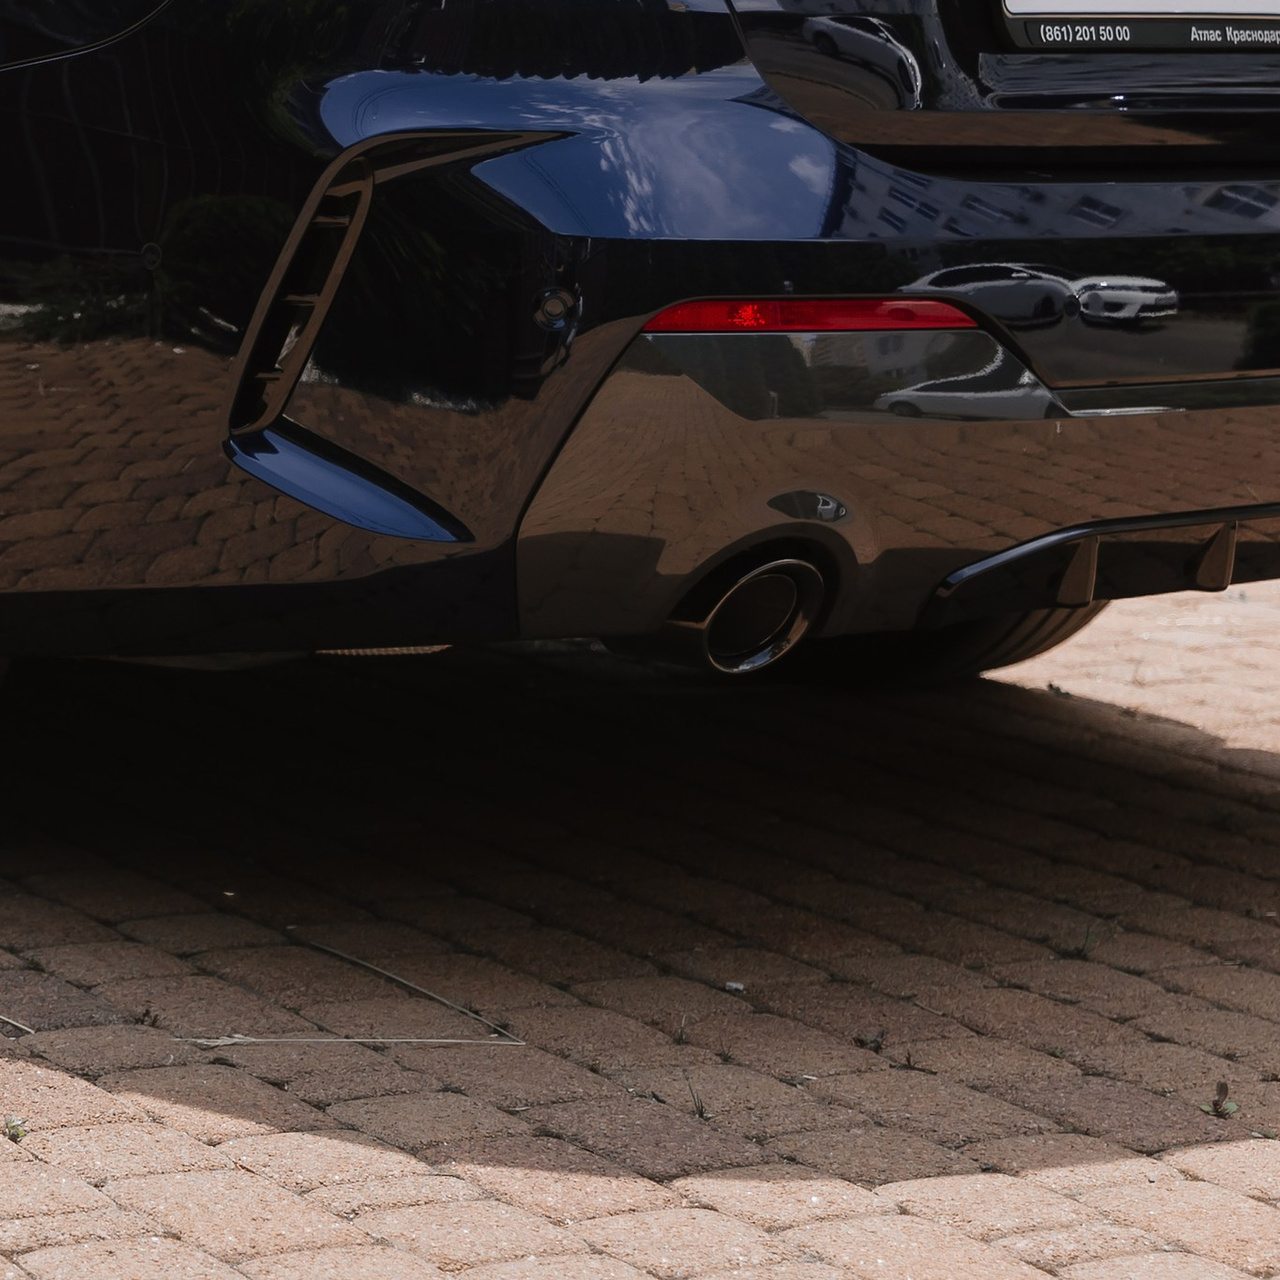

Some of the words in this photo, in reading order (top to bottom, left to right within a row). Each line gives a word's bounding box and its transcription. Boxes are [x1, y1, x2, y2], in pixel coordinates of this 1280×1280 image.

[1040, 25, 1073, 43] (861)
[1075, 26, 1097, 42] 201
[1099, 26, 1114, 42] 50
[1115, 26, 1131, 42] 00
[1190, 26, 1223, 42] Атлас
